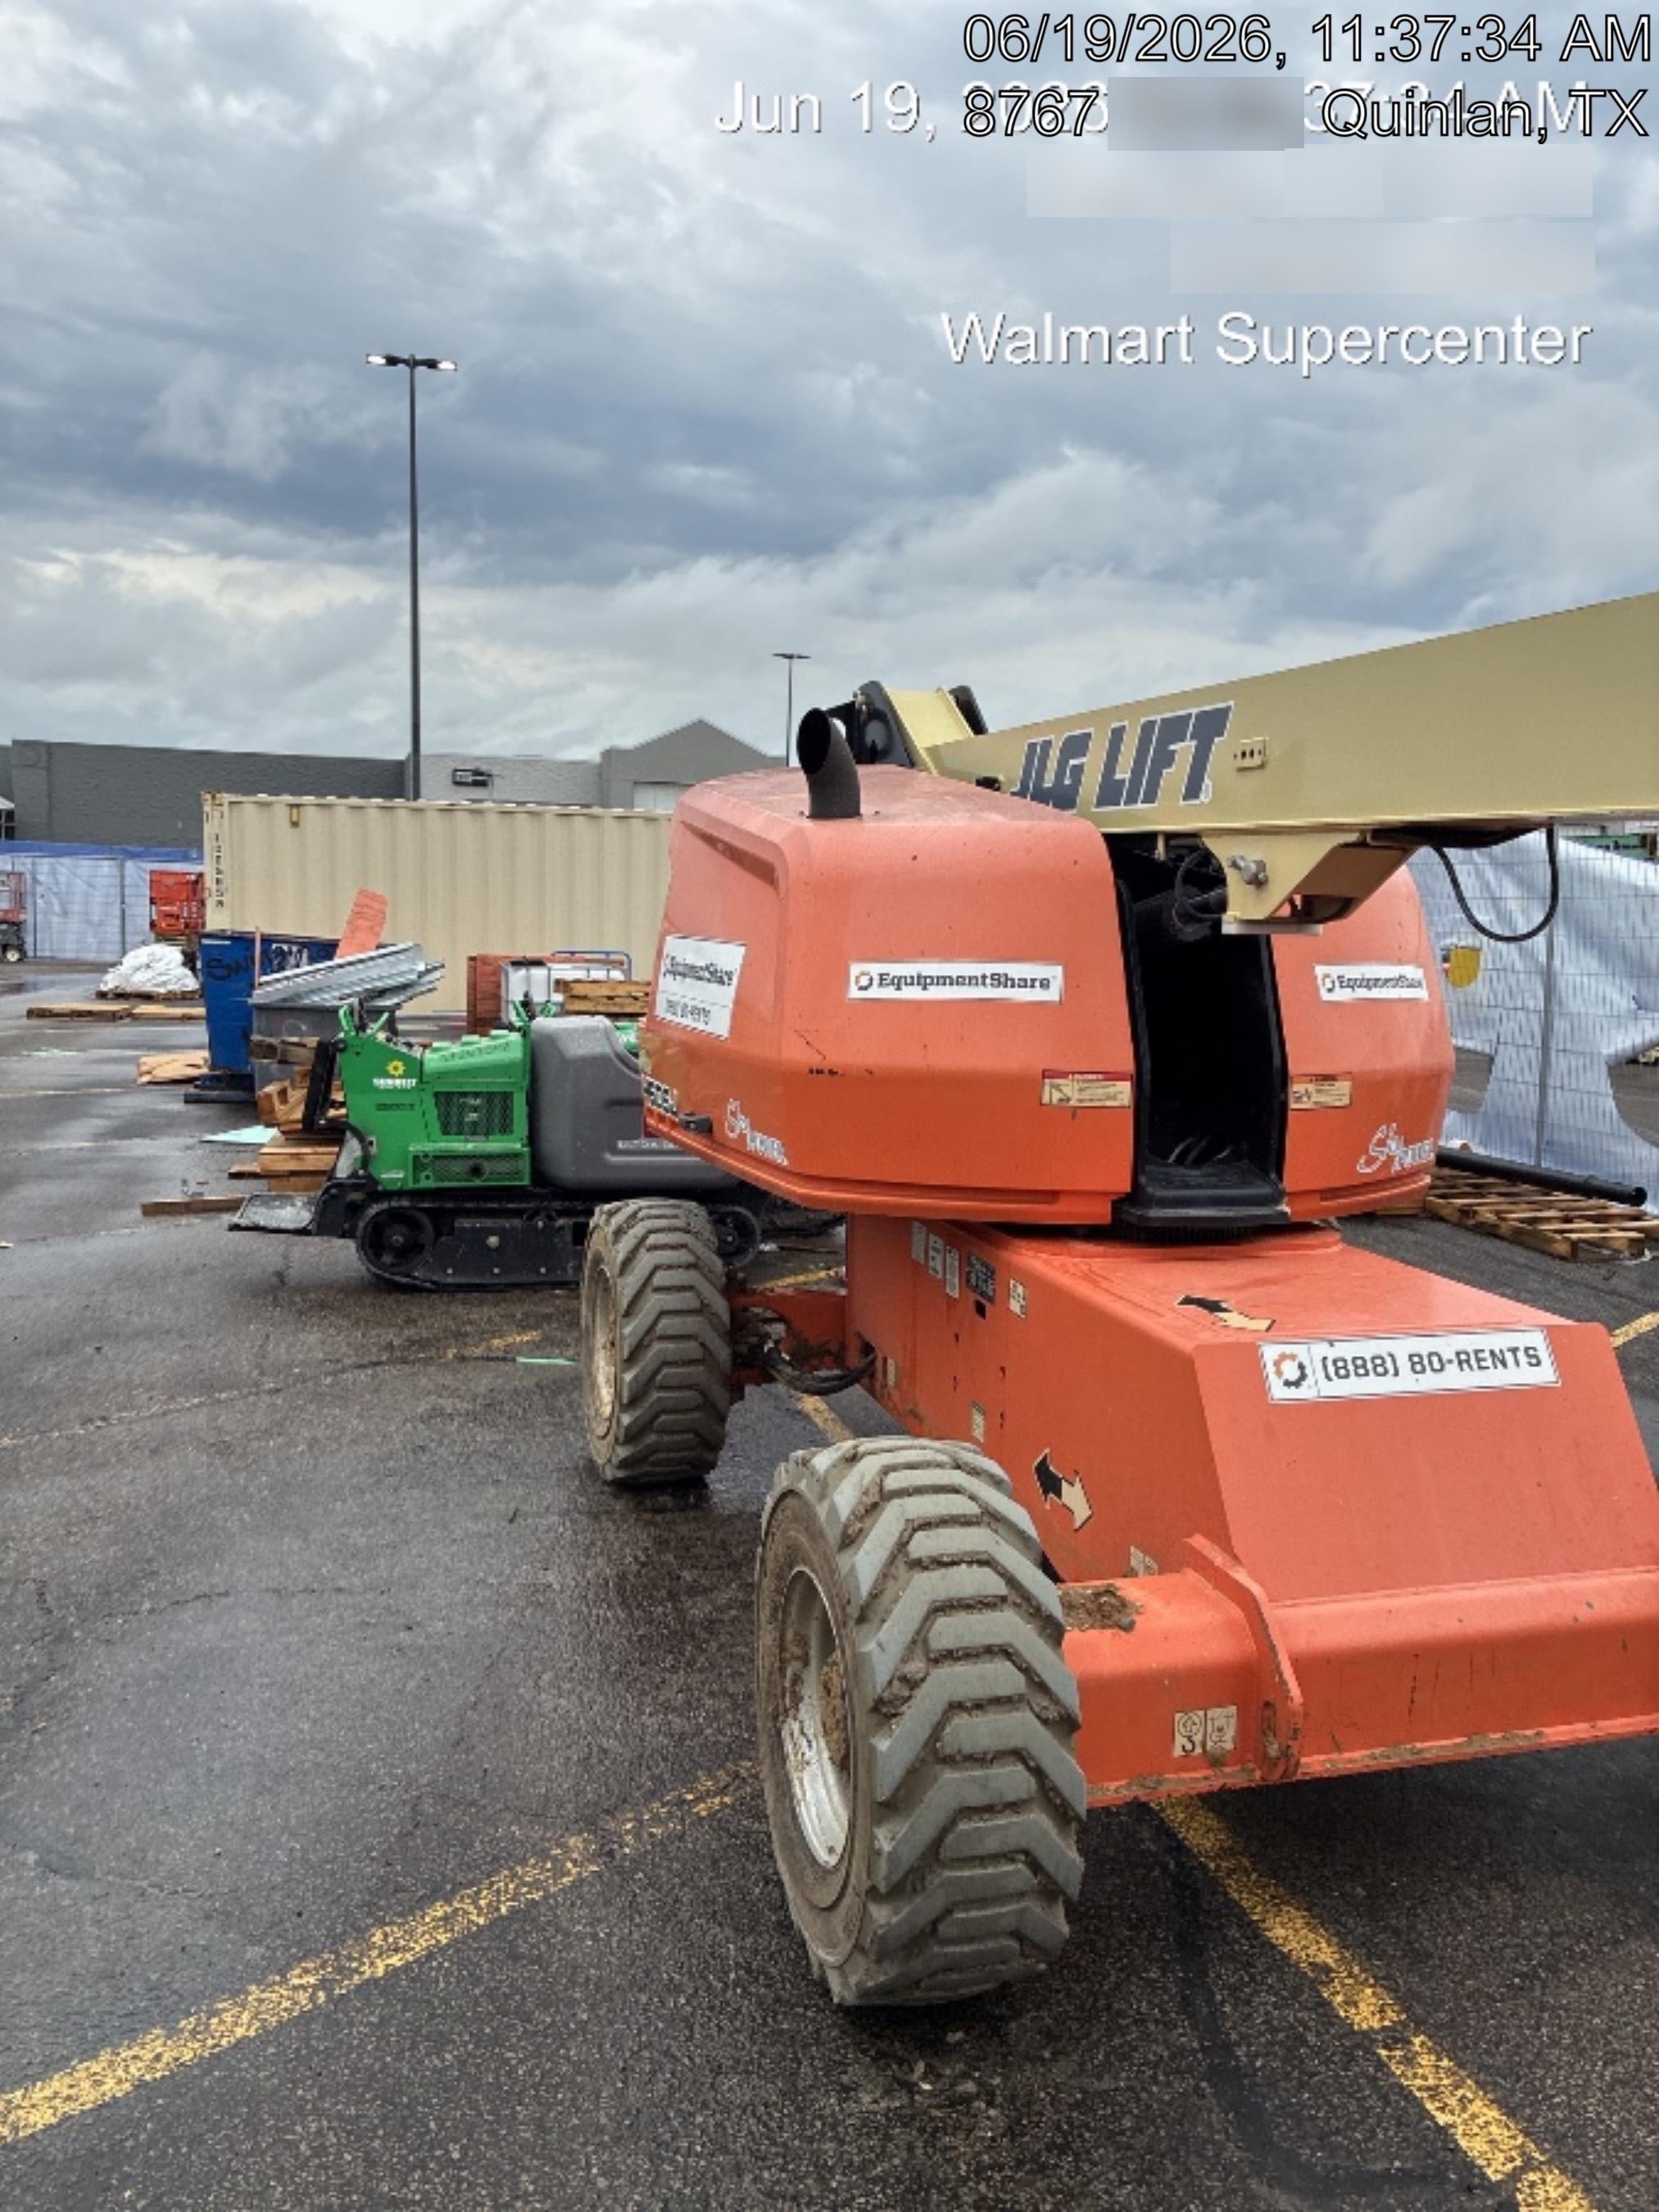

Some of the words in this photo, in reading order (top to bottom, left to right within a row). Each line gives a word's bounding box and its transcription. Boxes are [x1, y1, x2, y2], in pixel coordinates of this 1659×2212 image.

[1010, 728, 1094, 814] JLG
[1091, 700, 1235, 811] LIFT
[877, 972, 1051, 991] EquipmentShare
[1321, 1351, 1400, 1382] (888)
[1407, 1345, 1543, 1375] 80-RENTS
[1181, 1735, 1195, 1754] 3
